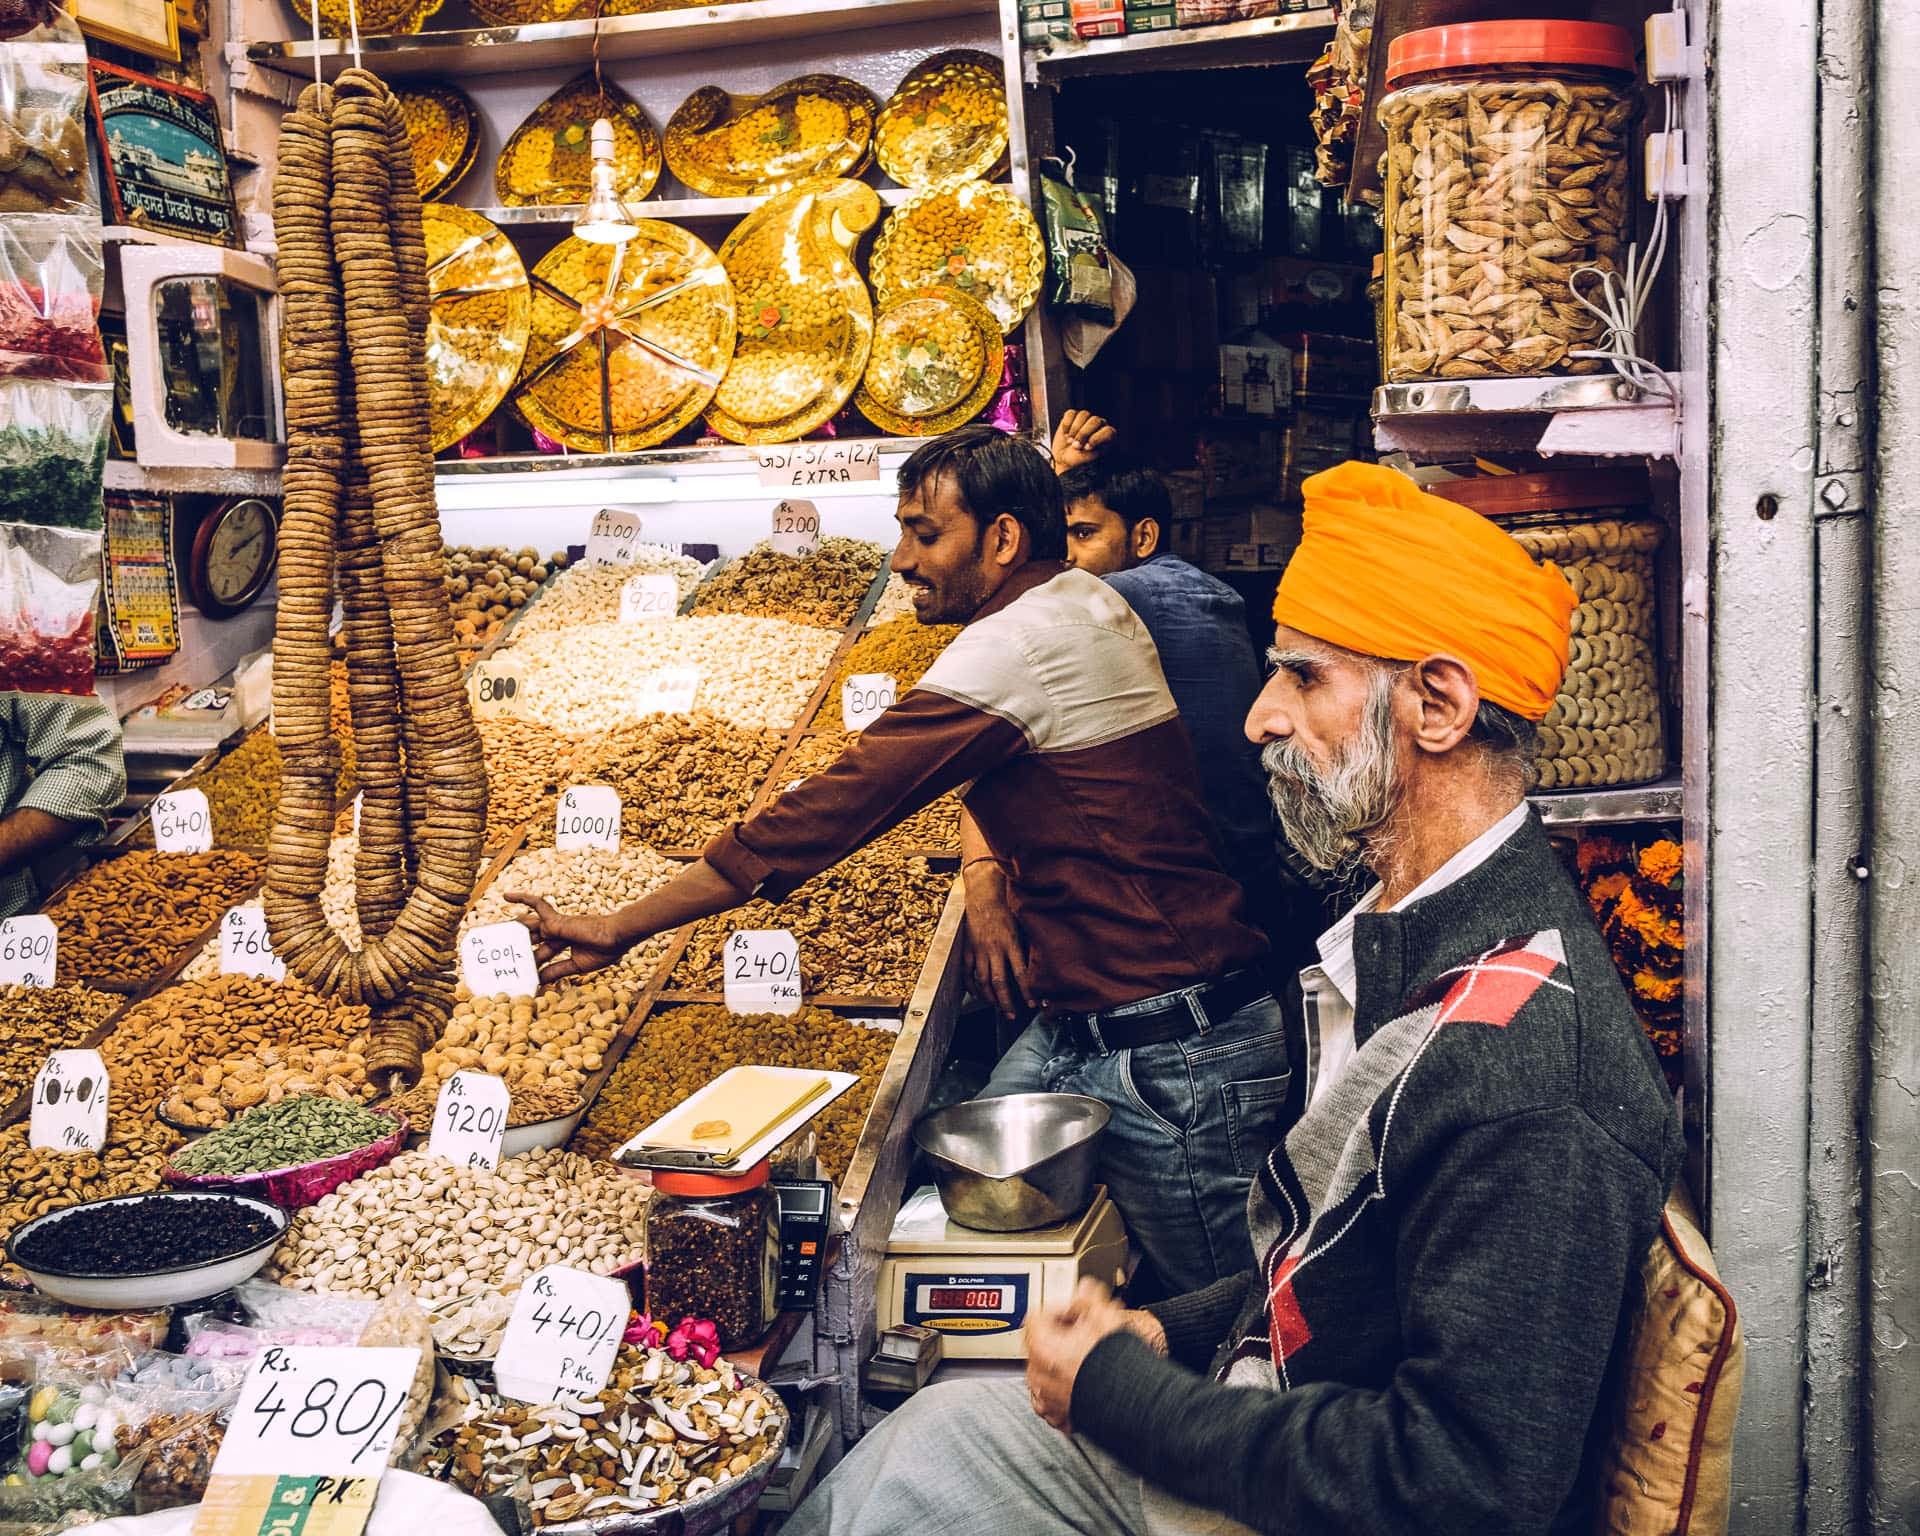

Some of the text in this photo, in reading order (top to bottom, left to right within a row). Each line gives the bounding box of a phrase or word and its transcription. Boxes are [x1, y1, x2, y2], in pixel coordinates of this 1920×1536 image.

[792, 468, 850, 485] EXTRA
[46, 1057, 64, 1075] Rs.
[448, 1077, 466, 1096] Rs.
[533, 1276, 557, 1297] Rs.
[259, 1348, 297, 1374] Rs.
